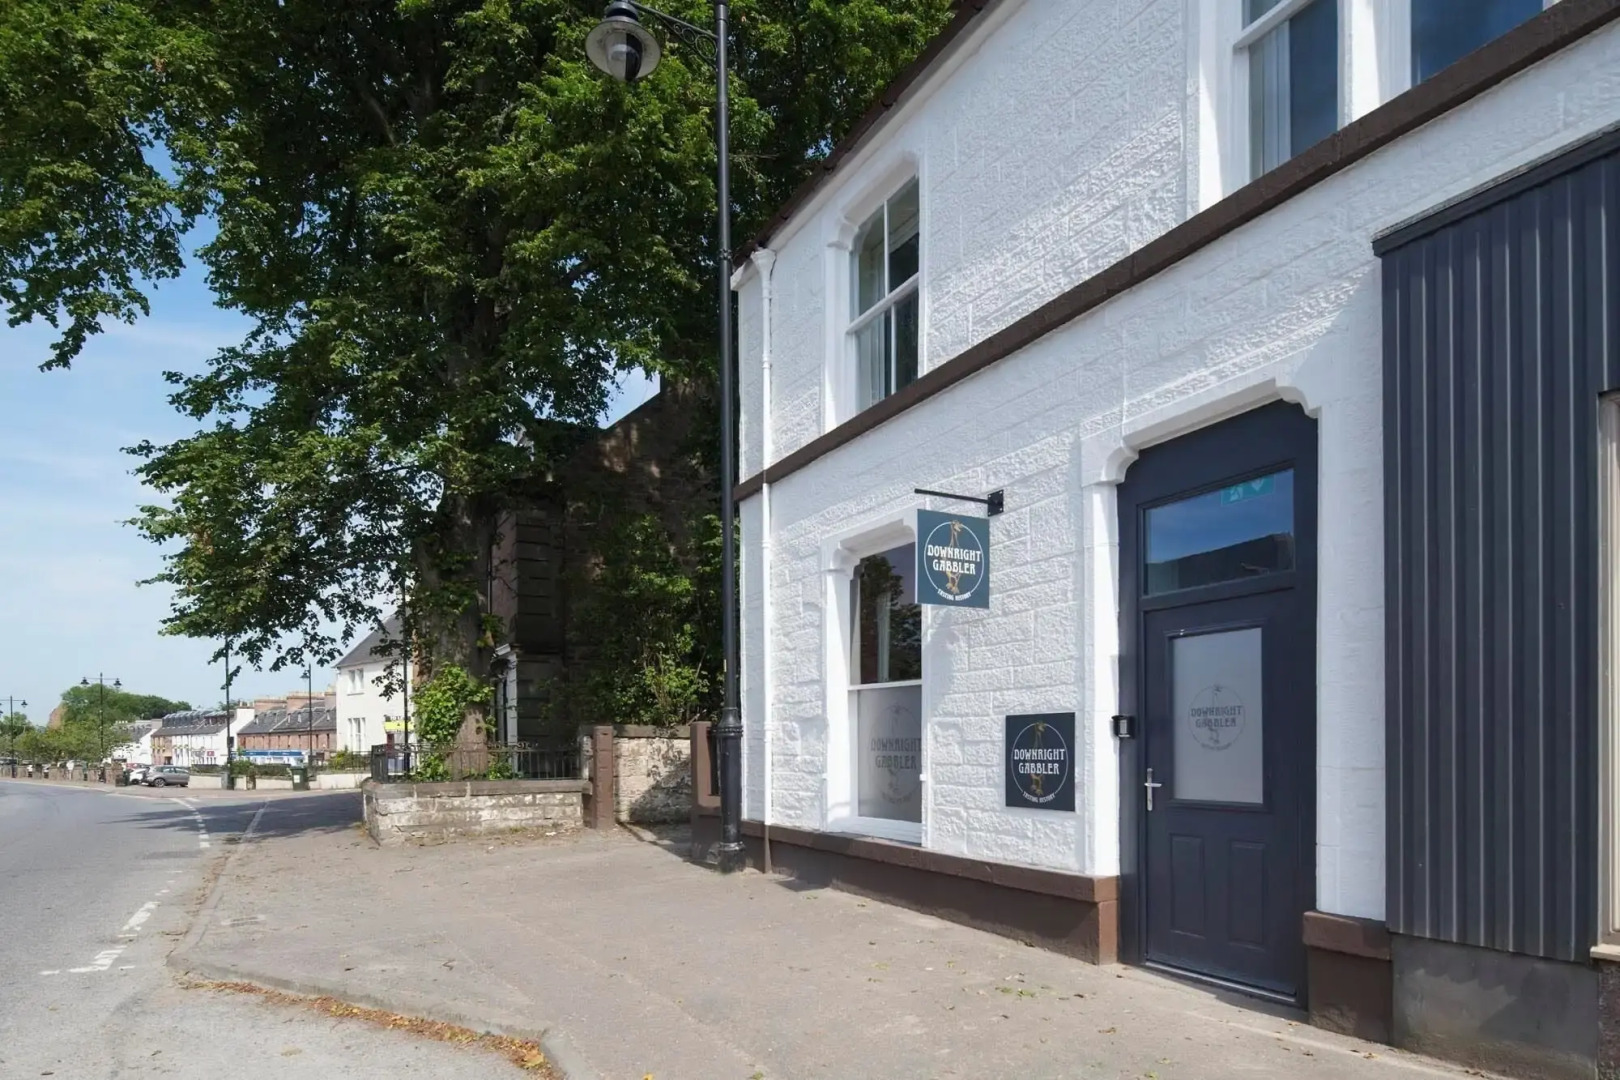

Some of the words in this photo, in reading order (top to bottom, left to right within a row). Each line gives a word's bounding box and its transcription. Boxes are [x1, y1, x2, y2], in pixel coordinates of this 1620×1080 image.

[927, 544, 981, 562] DOWNRIGHT
[932, 559, 976, 575] GABBLER
[1191, 705, 1244, 717] DOWNRIGHT
[1013, 748, 1065, 760] DOWNRIGHT
[1018, 762, 1060, 775] GABBLER
